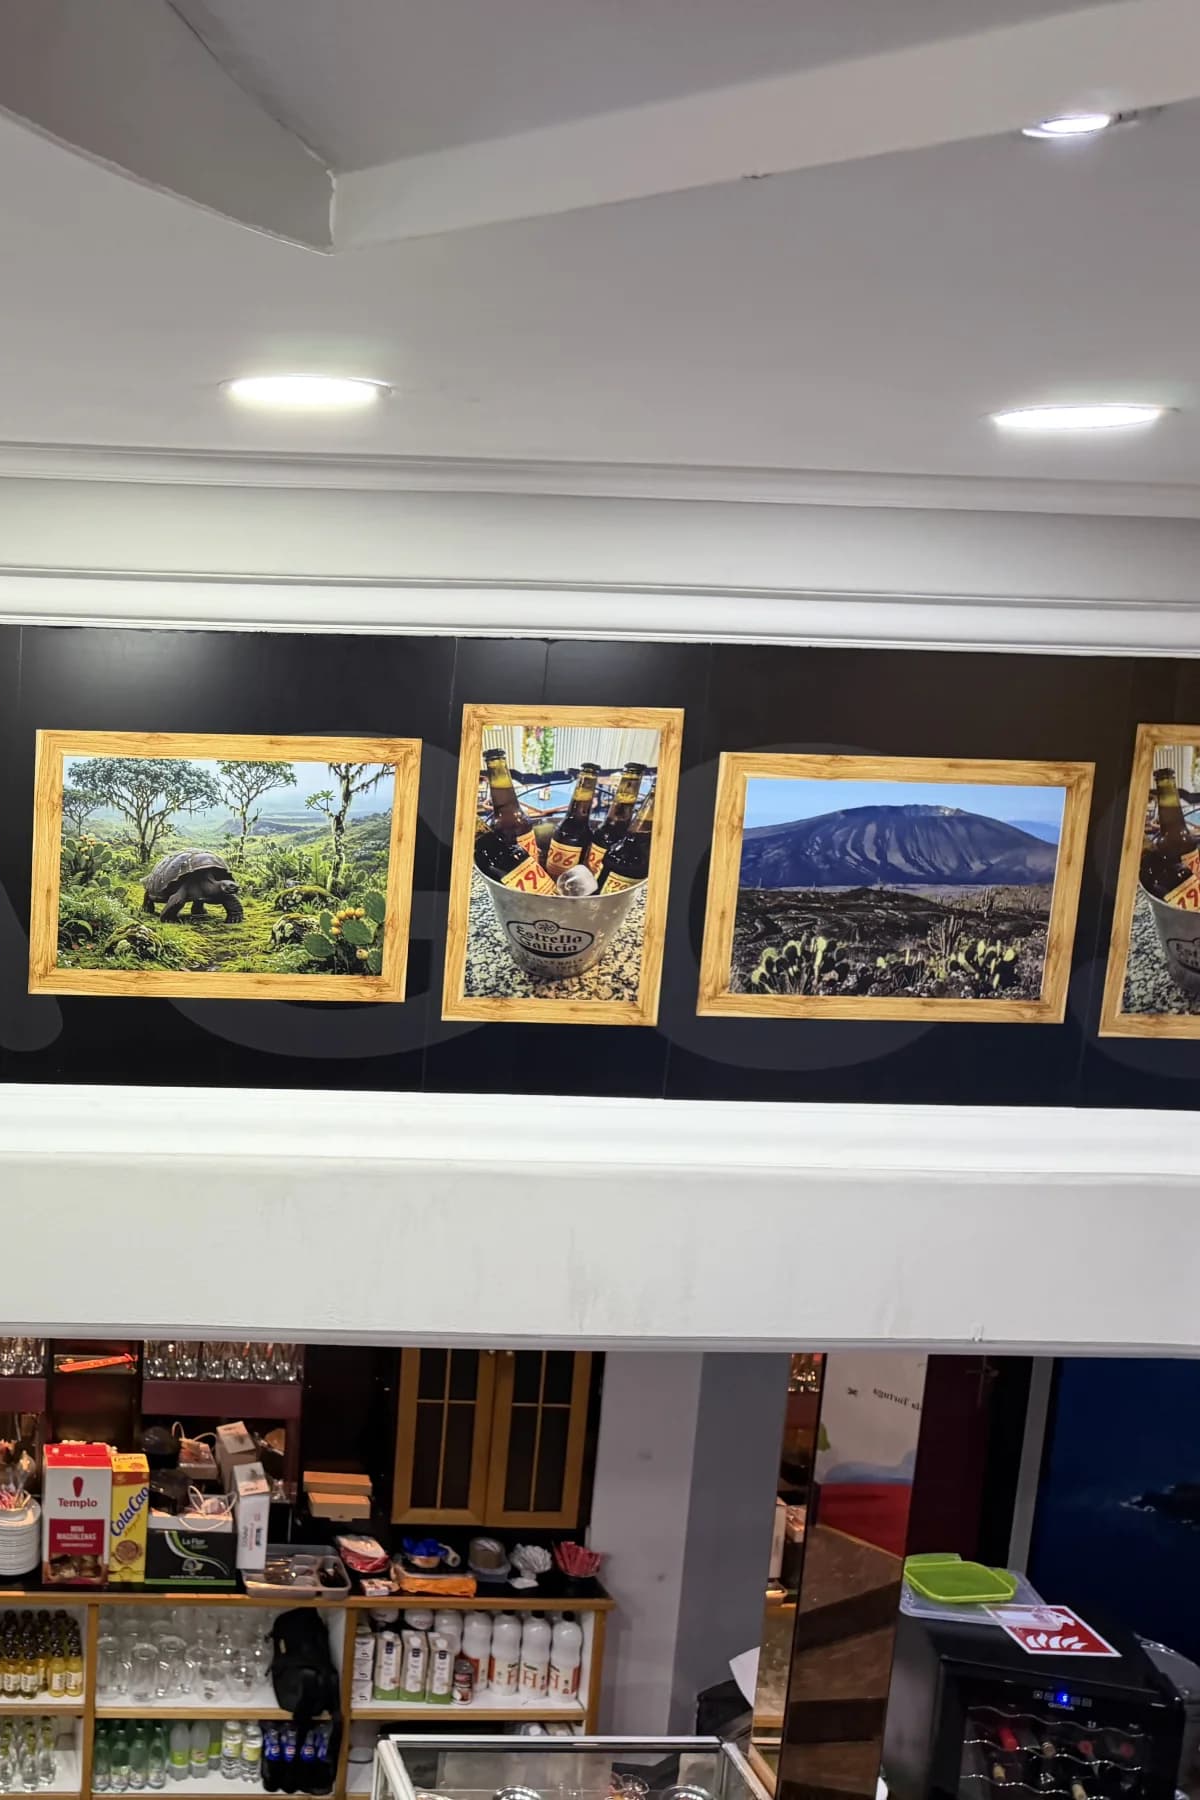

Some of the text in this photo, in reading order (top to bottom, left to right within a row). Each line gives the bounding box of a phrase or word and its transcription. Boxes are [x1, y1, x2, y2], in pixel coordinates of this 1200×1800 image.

[515, 863, 546, 892] 190
[516, 925, 582, 943] Estrella
[520, 935, 577, 952] Galicia
[58, 1497, 98, 1510] Templo
[110, 1486, 149, 1537] ColaCao
